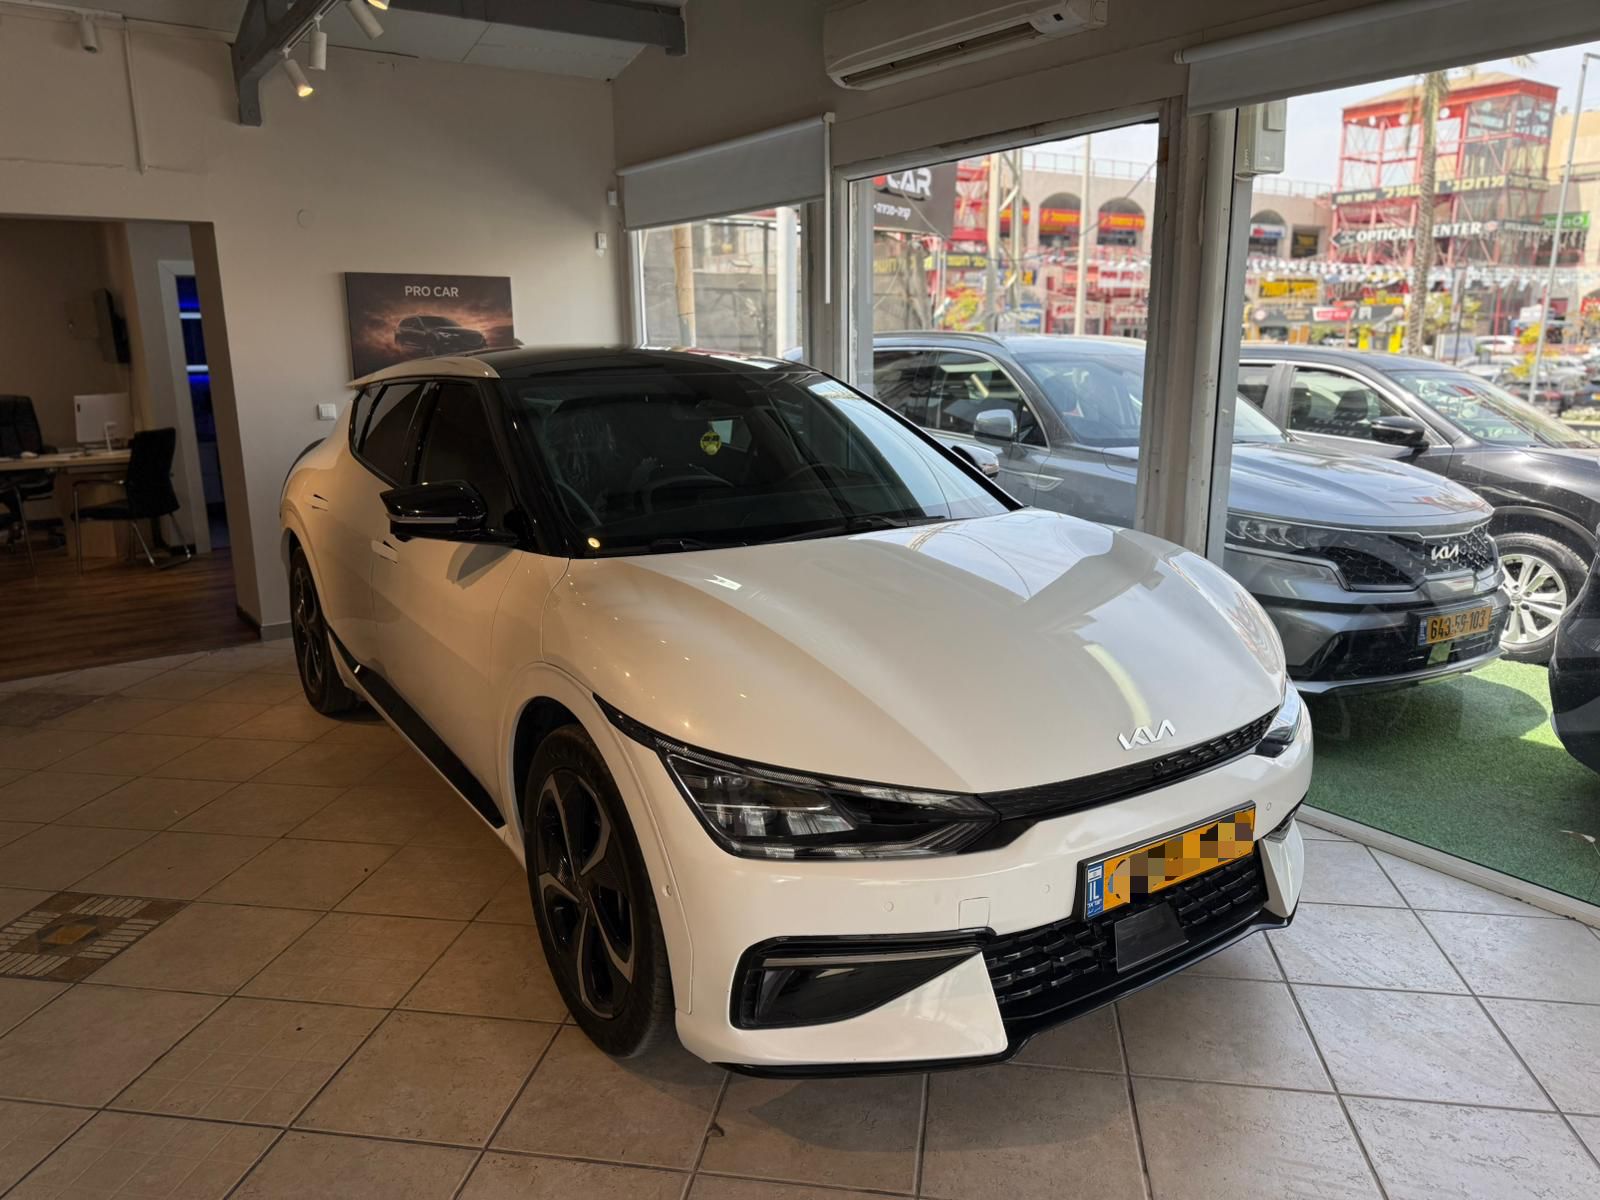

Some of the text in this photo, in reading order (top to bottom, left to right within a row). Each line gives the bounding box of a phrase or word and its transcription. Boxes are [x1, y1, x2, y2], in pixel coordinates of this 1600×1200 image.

[1356, 227, 1416, 242] OPTICAL
[1432, 221, 1483, 238] ENTER
[405, 285, 459, 297] PRO CAR
[1431, 544, 1459, 560] KIA
[1117, 719, 1176, 750] KIA
[1089, 881, 1100, 902] IL
